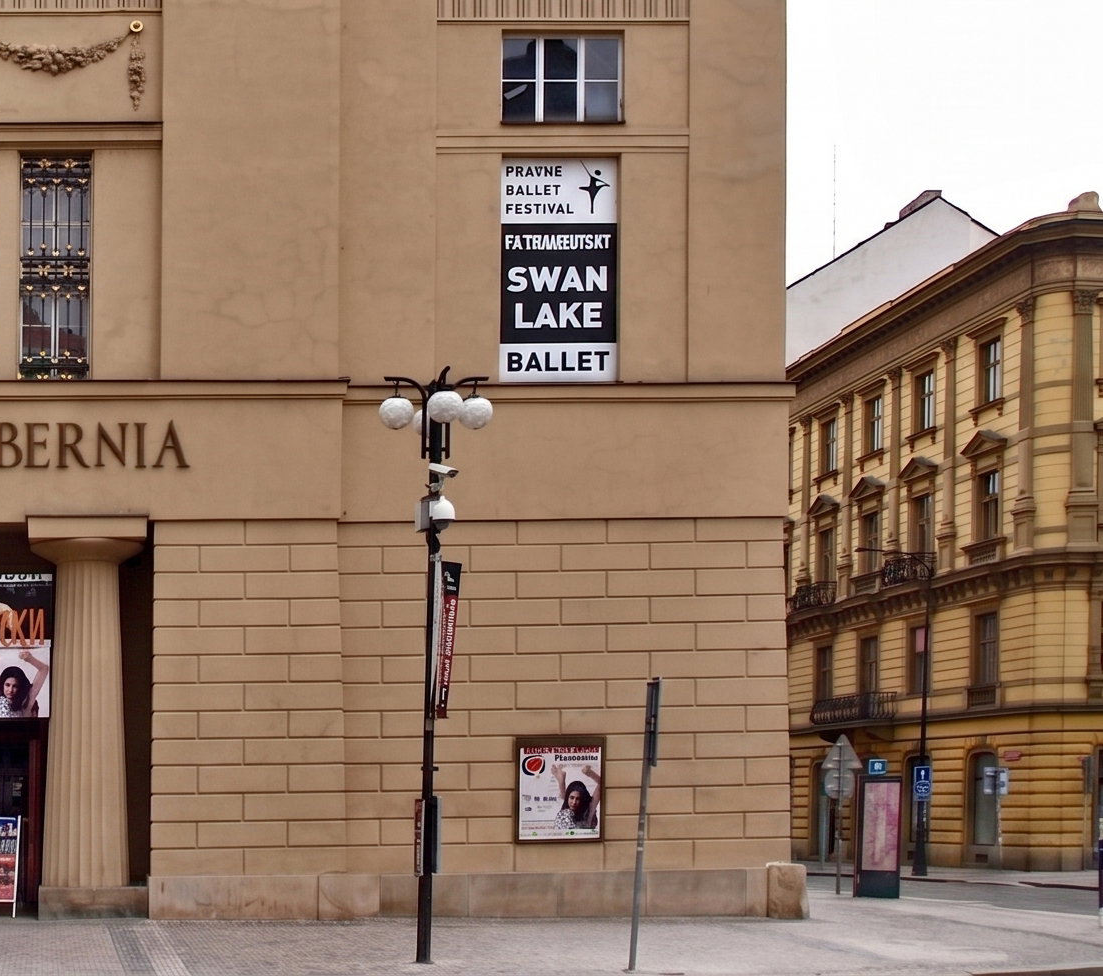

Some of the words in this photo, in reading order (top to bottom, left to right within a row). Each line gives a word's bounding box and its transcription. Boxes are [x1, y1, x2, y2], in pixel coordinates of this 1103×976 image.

[506, 184, 561, 196] BALLET
[506, 203, 574, 215] FESTIVAL
[506, 266, 608, 292] SWAN
[514, 302, 602, 329] LAKE
[507, 351, 610, 372] BALLET
